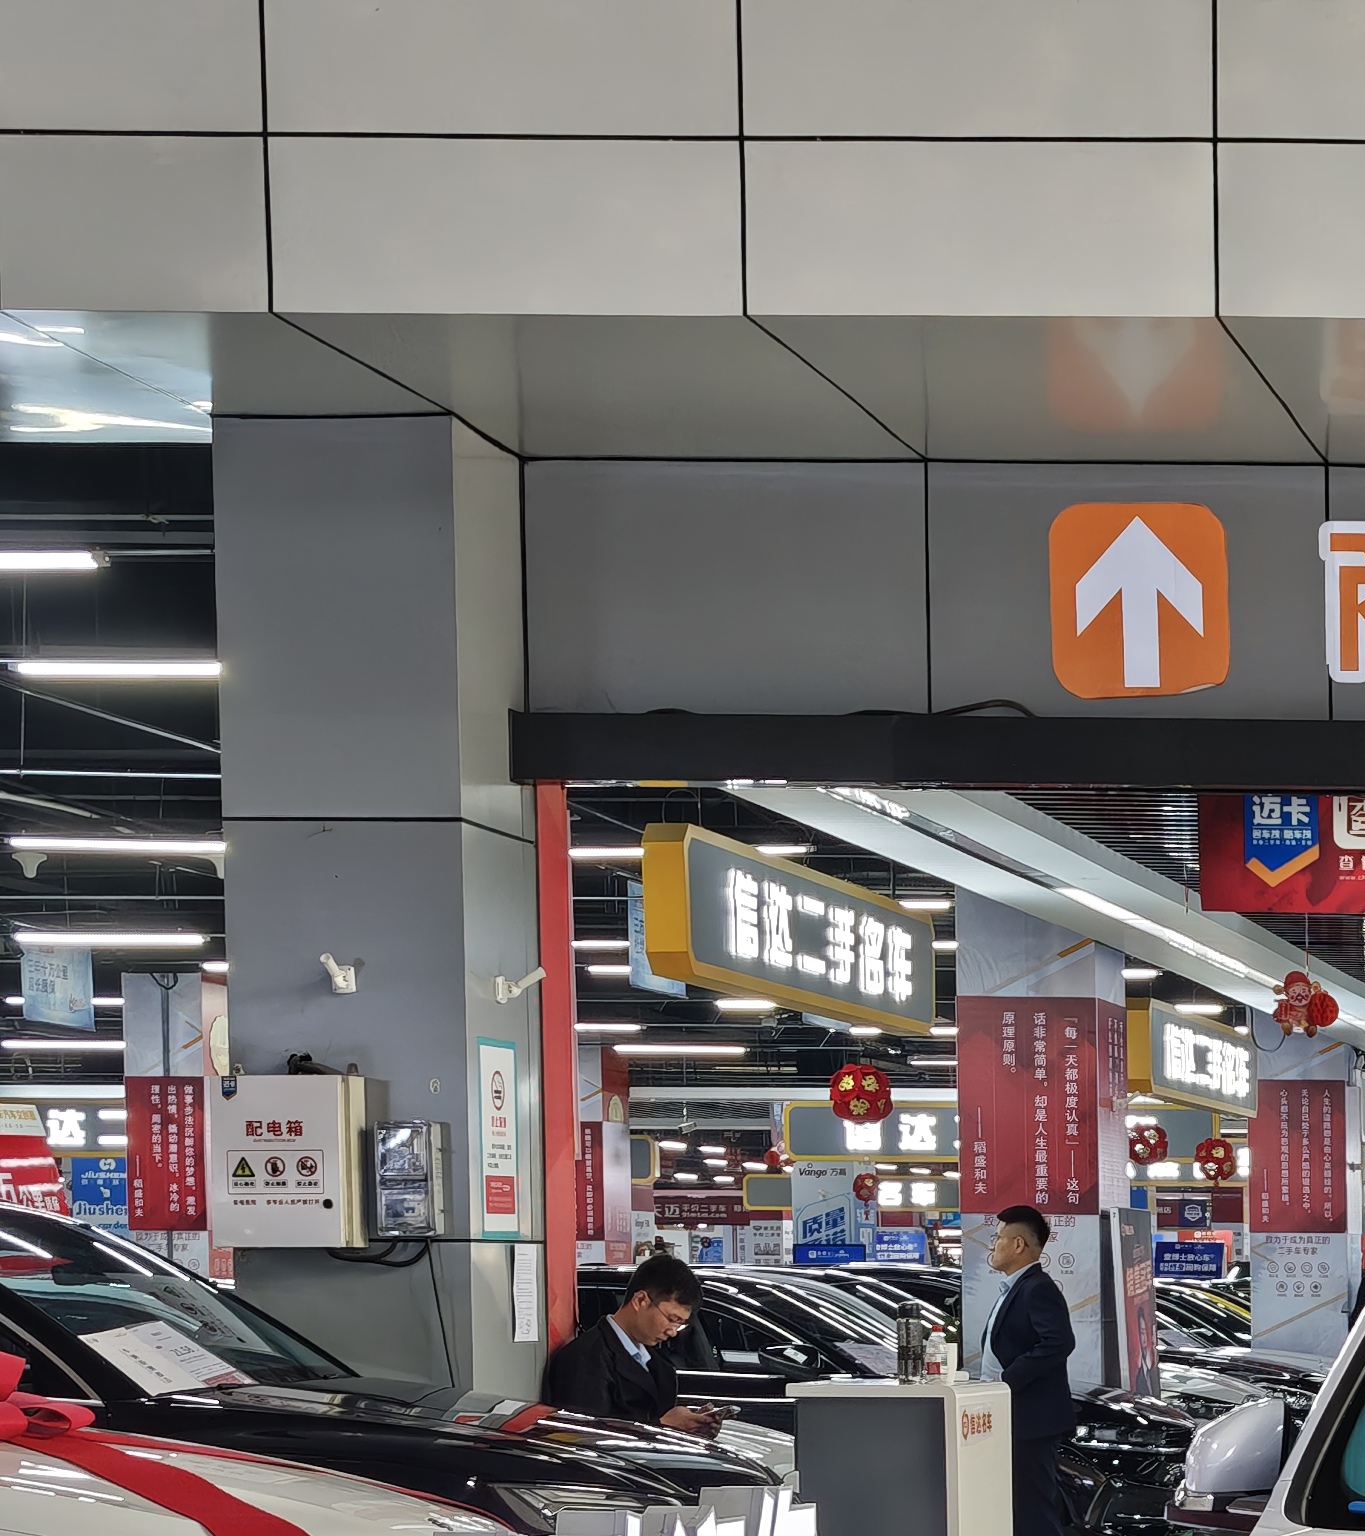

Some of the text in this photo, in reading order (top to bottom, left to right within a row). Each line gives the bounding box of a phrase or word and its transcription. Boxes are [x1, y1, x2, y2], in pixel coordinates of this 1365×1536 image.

[1252, 794, 1312, 826] 迈卡
[245, 1119, 305, 1138] 配电箱
[801, 1206, 846, 1240] 质量
